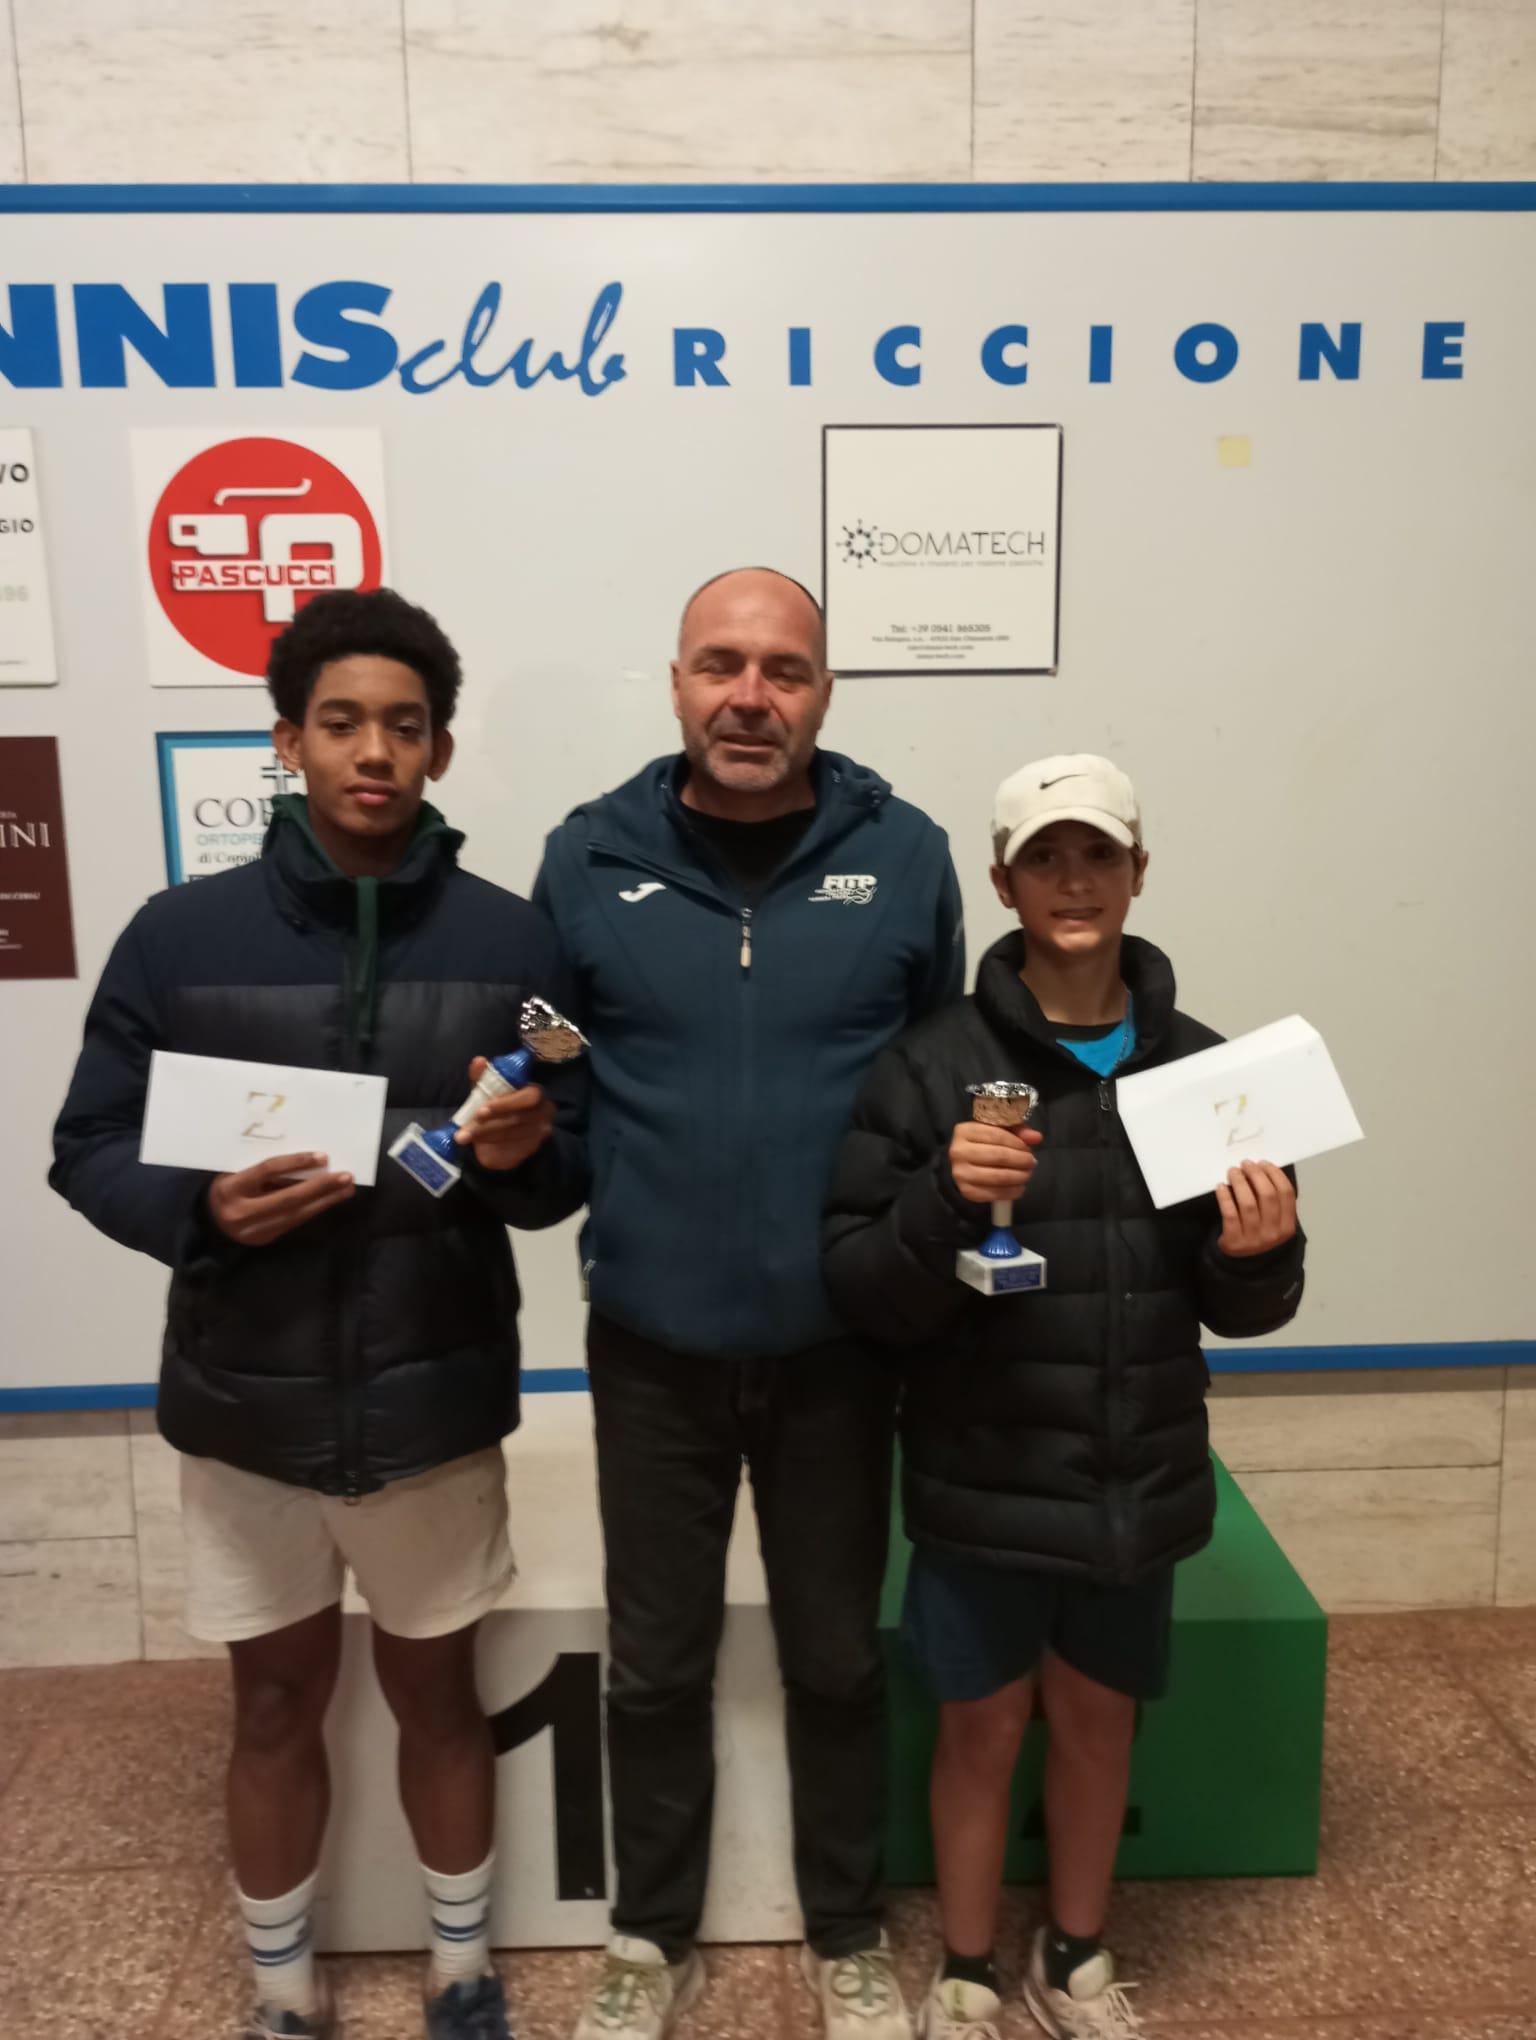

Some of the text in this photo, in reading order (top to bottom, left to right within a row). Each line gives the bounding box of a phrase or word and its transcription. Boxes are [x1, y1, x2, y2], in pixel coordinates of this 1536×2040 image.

[398, 281, 627, 396] club
[672, 322, 1465, 387] RICCIONE
[177, 564, 336, 587] PASCUCCI
[880, 530, 1046, 556] DOMATECH
[486, 1652, 608, 1901] 1
